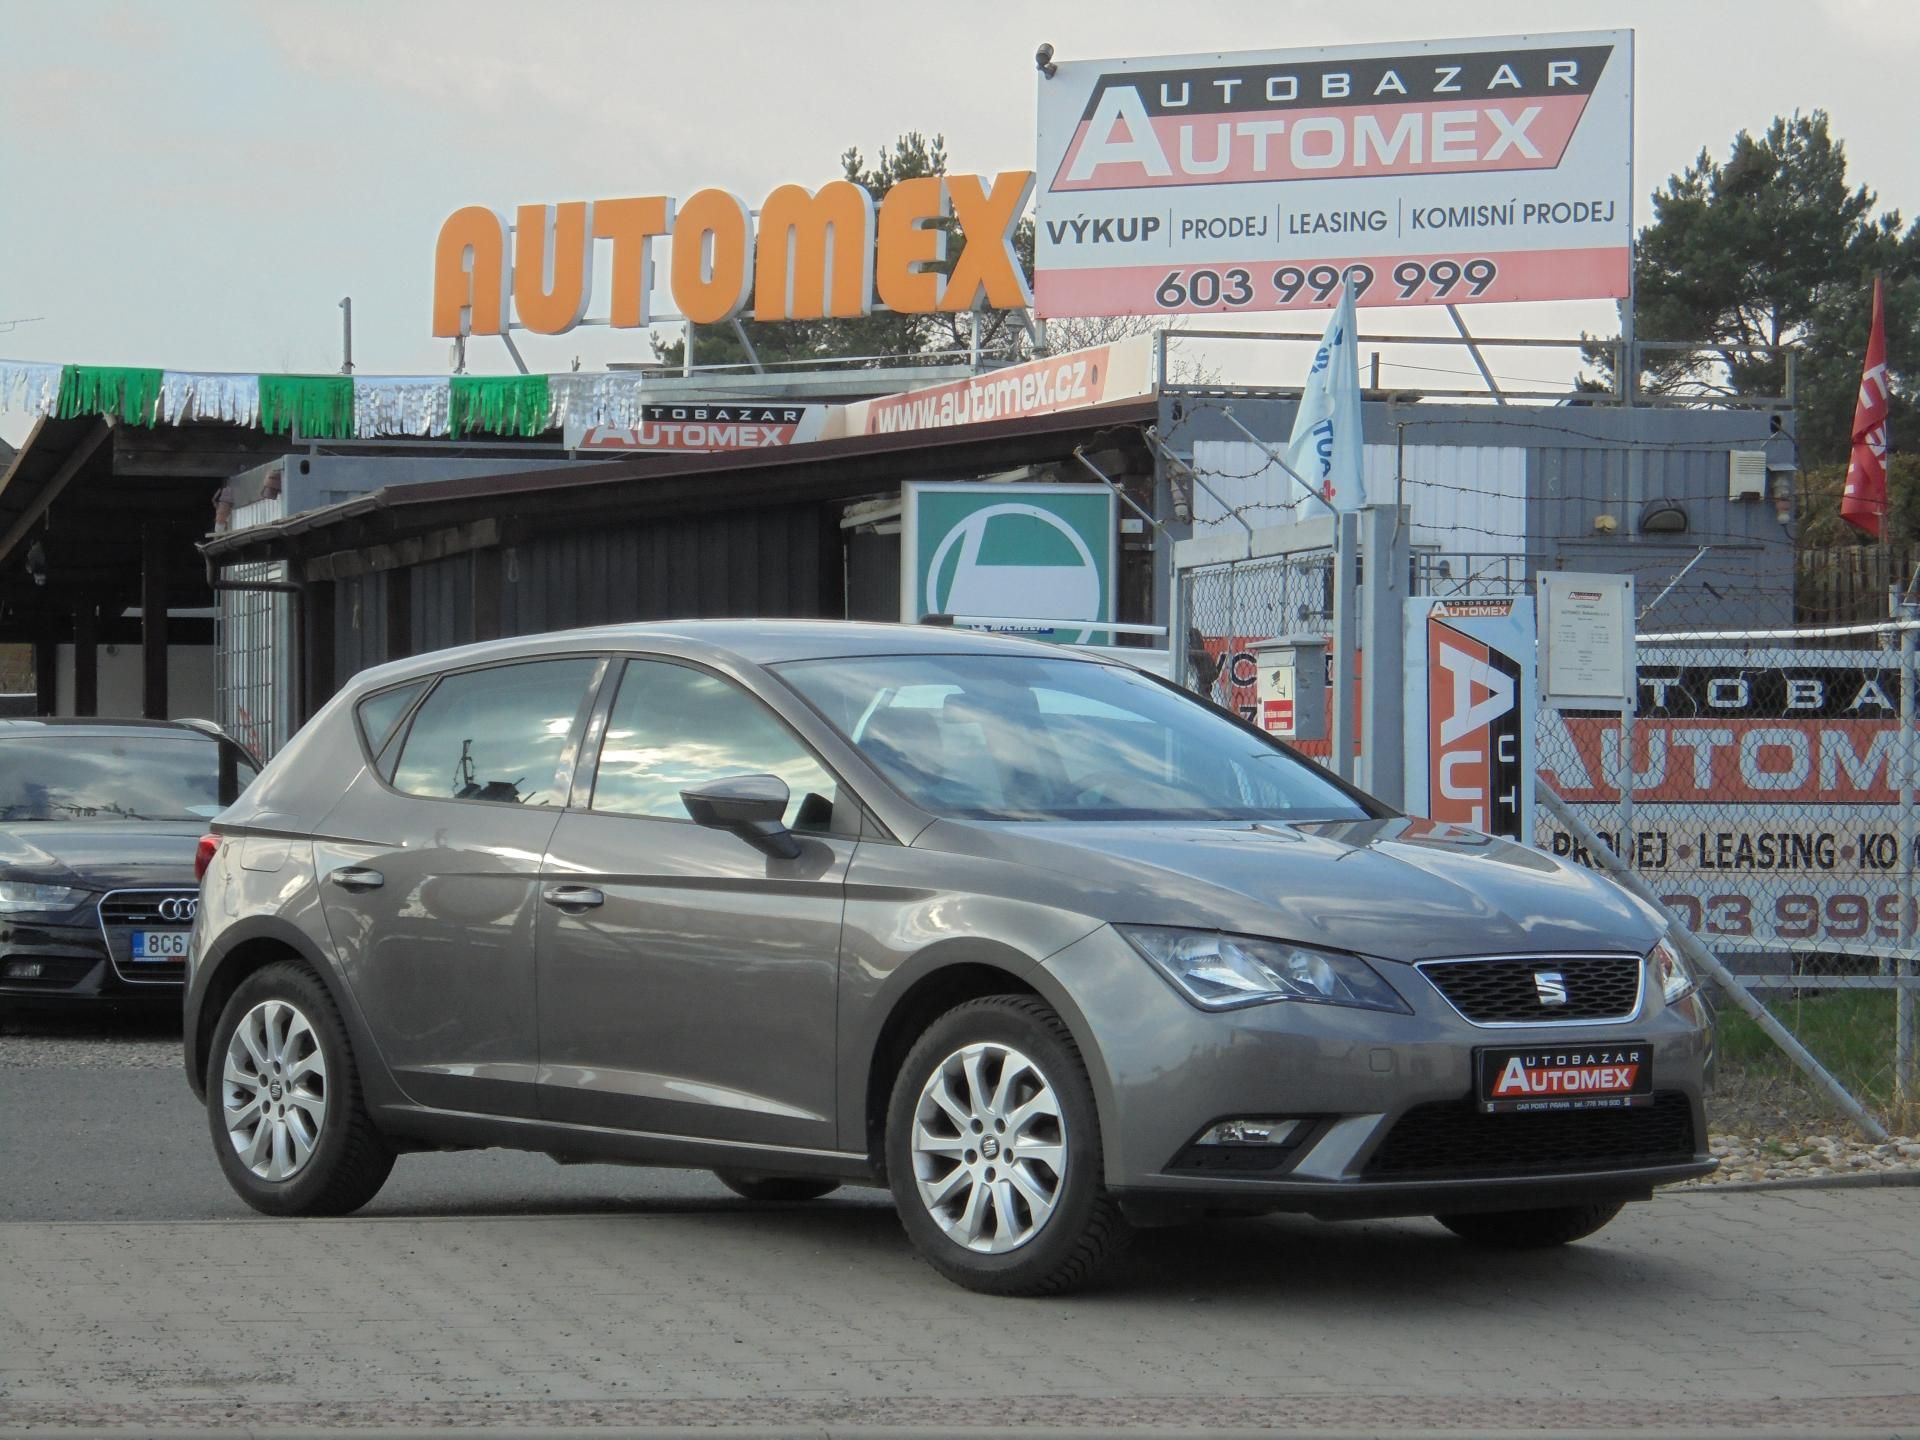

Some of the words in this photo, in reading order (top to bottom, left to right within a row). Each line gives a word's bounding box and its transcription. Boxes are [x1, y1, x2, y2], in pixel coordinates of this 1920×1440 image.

[1066, 85, 1543, 181] AUTOMEX
[1046, 213, 1160, 245] VÝKUP
[1181, 215, 1268, 240] PRODEJ
[1289, 210, 1388, 235] LEASING
[1412, 198, 1515, 229] KOMISNÍ
[1523, 200, 1615, 225] PRODEJ
[432, 170, 1036, 338] AUTOMEX
[1155, 269, 1254, 308] 603
[1272, 264, 1375, 304] 999
[1393, 258, 1498, 299] 999
[878, 361, 1087, 433] www.automex.cz
[1431, 601, 1507, 616] AUTOMEX
[1700, 833, 1835, 869] LEASING
[1497, 1057, 1630, 1093] AUTOMEX
